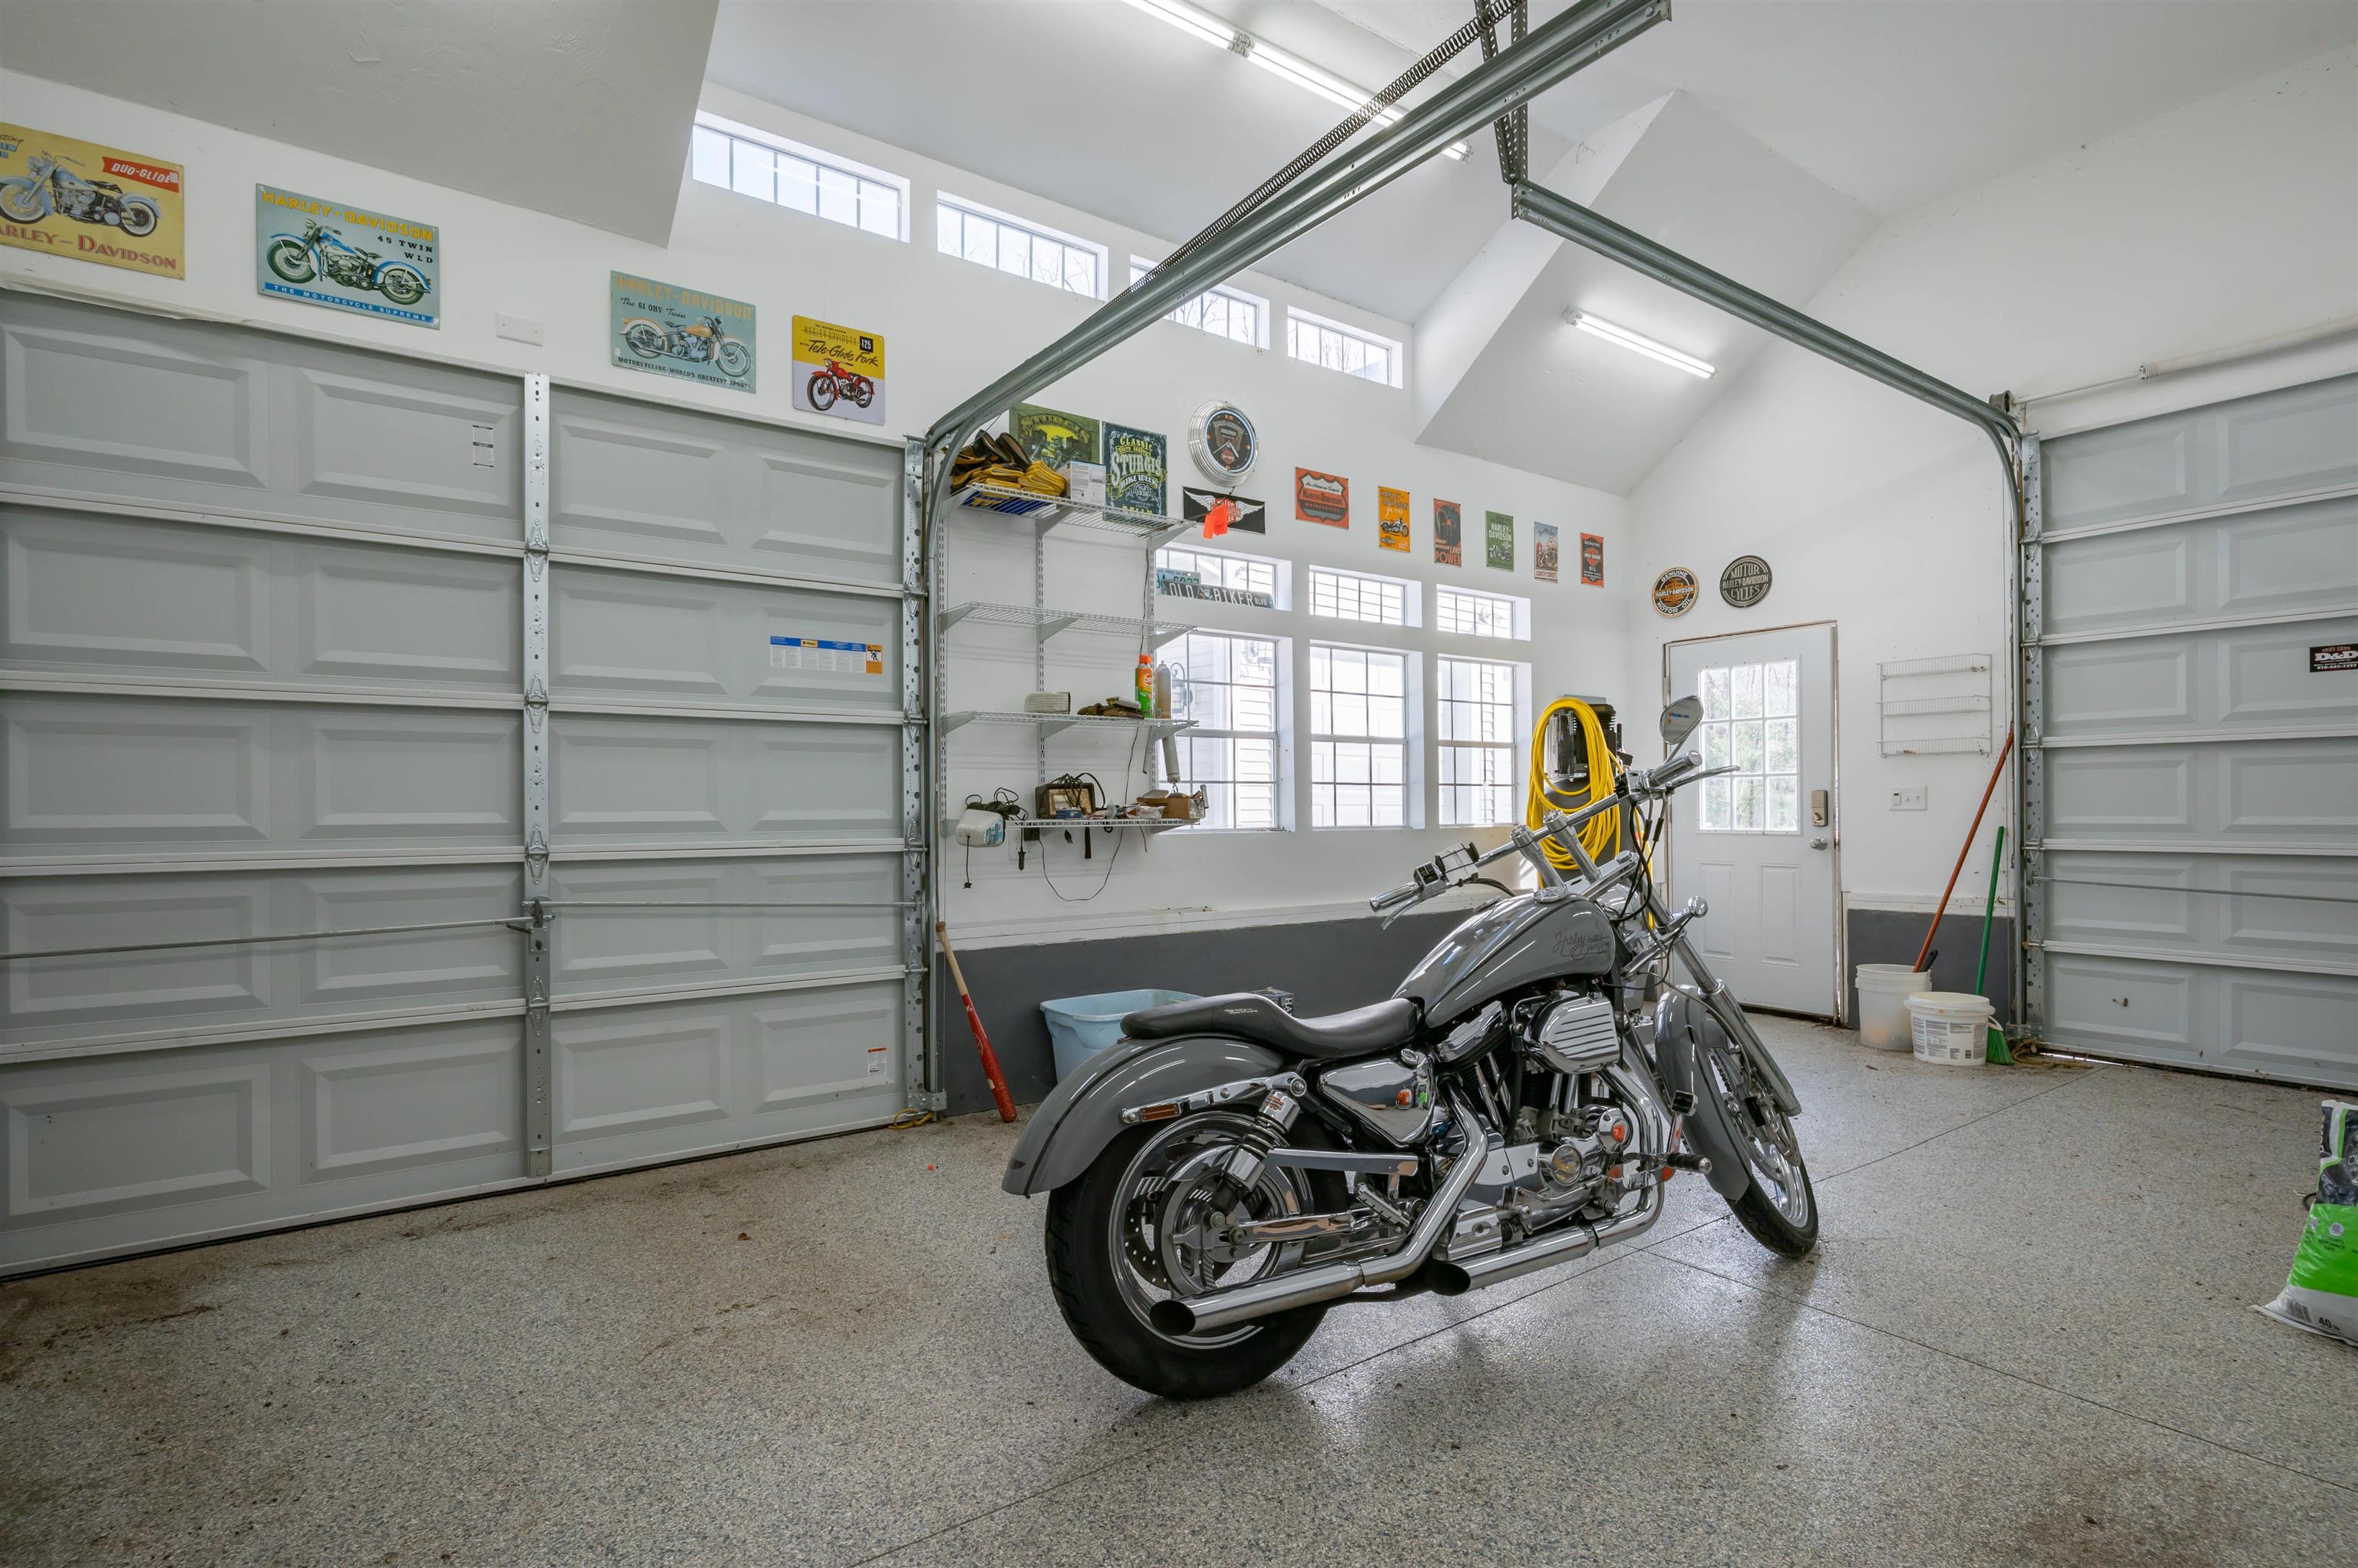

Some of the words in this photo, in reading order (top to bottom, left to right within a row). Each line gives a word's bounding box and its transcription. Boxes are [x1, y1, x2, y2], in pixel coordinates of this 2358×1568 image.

[111, 162, 171, 184] DUO-GLIDE
[262, 190, 434, 243] HARLEY-DAVIDSON
[0, 223, 177, 270] ARLEY-DAVIDSON
[377, 235, 392, 244] 45
[398, 239, 433, 253] TWIN
[404, 252, 434, 264] WLD
[273, 284, 296, 295] THE
[302, 291, 374, 312] MOTORCYCLE
[379, 307, 427, 322] SUPREME
[616, 274, 753, 320] HARLEY-DAVIDSON
[620, 297, 636, 307] The
[638, 302, 646, 310] 61
[648, 304, 663, 315] OHV
[666, 309, 687, 319] Twin
[861, 338, 872, 350] 125
[808, 339, 854, 361] Tele-Glide
[855, 352, 879, 368] Fork
[697, 374, 727, 385] GREATEST
[1120, 436, 1153, 452] CLASSIC
[1110, 451, 1162, 487] STURGIS
[1121, 474, 1137, 489] BIKE
[1138, 474, 1158, 486] WEEK
[1488, 530, 1512, 542] DAVIDSON
[1491, 523, 1511, 533] HARLEY-
[1660, 570, 1689, 583] GENUINE
[1730, 563, 1760, 579] MOTOR
[1722, 574, 1769, 589] HARLEY-DAVIDSON
[1169, 583, 1194, 599] OLD
[1213, 588, 1254, 606] BIKER
[1655, 586, 1695, 598] HARLEY-DAVIDSON
[1730, 585, 1761, 601] CYCLES
[1656, 602, 1679, 614] MOTOR
[1682, 597, 1693, 609] OIL
[2318, 1316, 2333, 1329] 40
